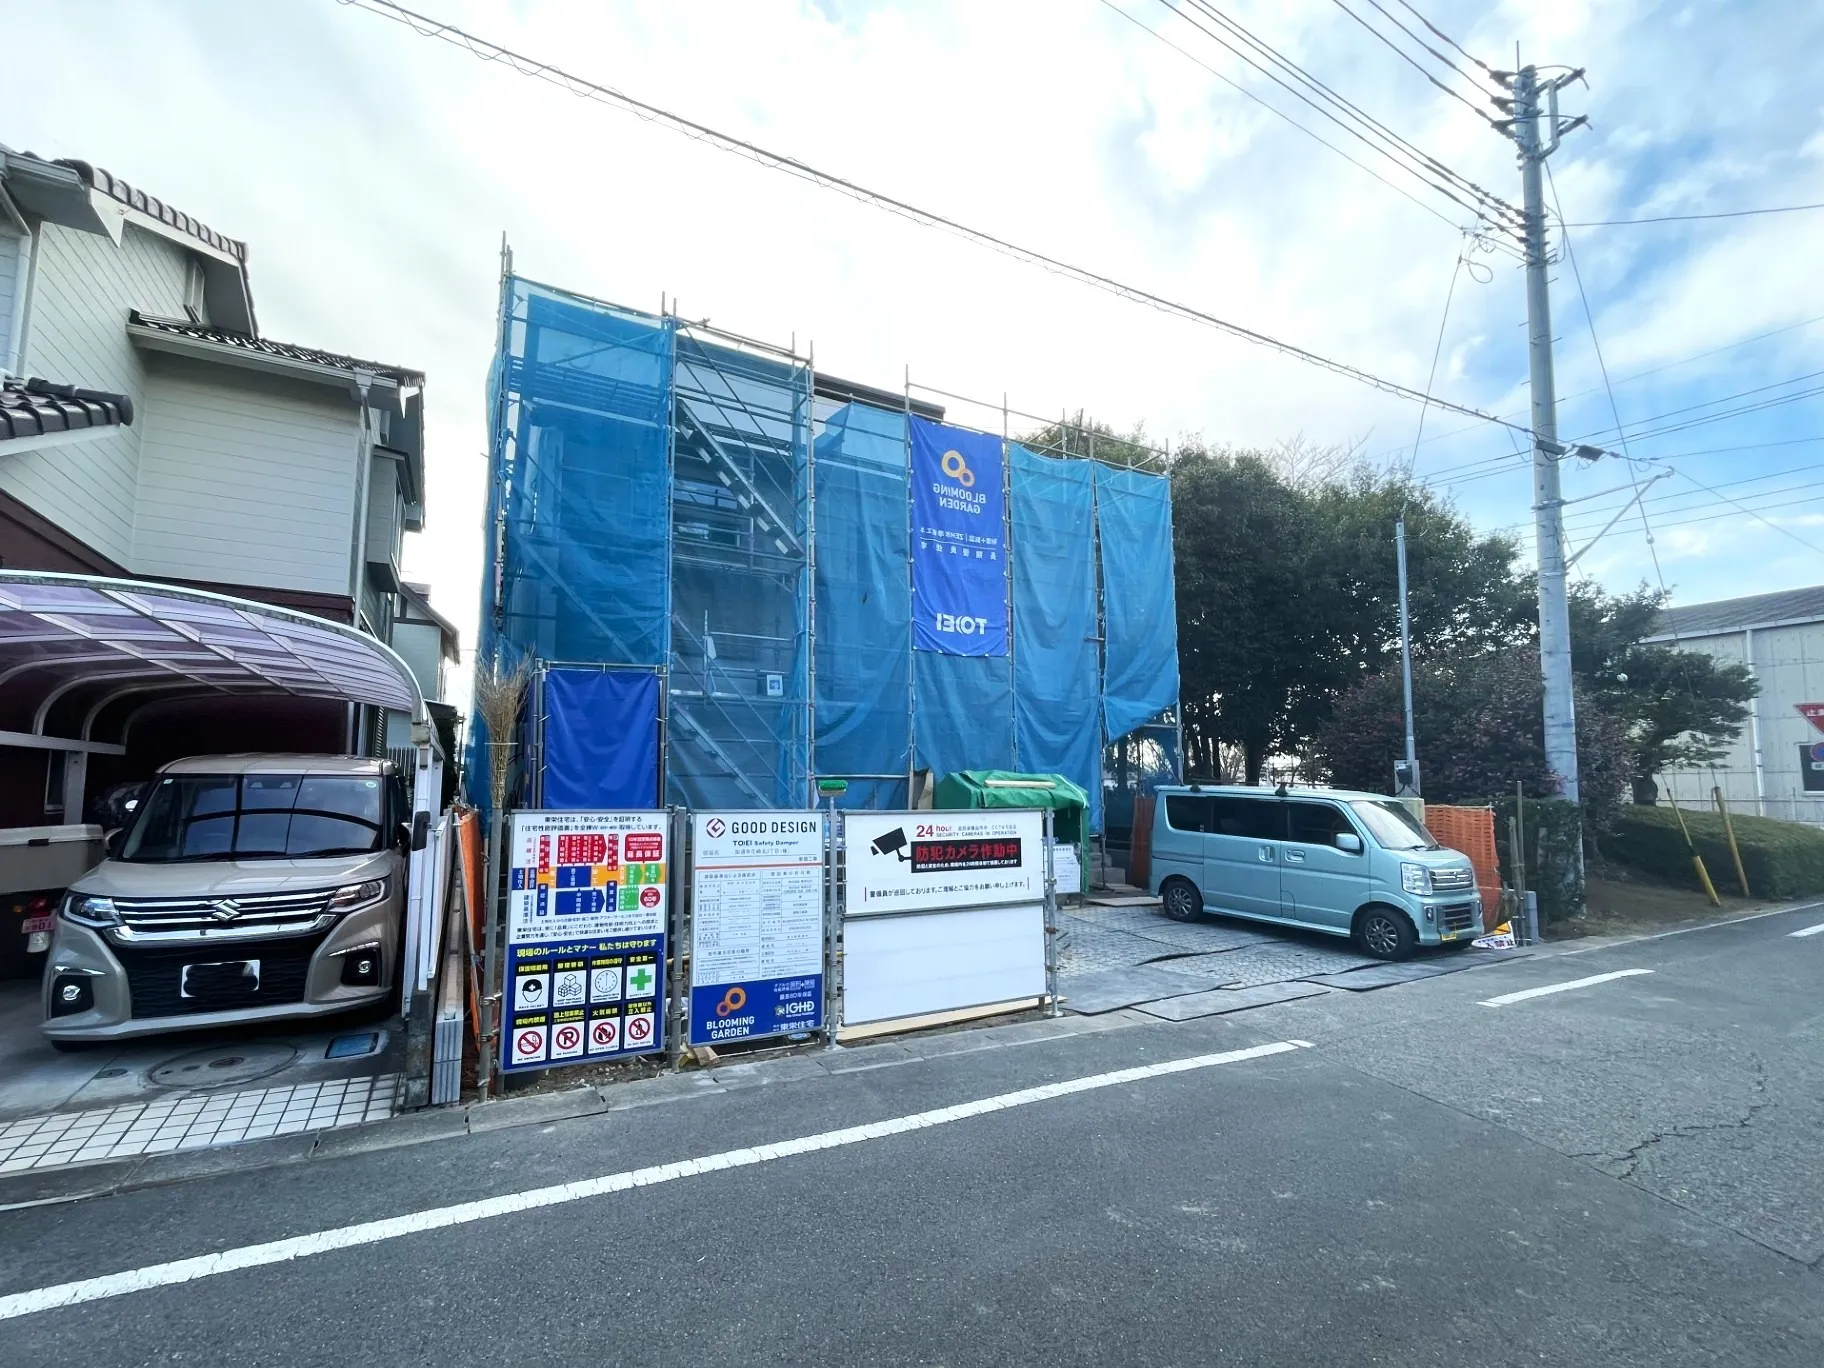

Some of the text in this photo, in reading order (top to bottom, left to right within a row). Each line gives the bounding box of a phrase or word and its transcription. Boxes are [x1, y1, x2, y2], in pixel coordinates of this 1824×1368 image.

[732, 822, 816, 834] GOOD DESIGN
[916, 825, 934, 838] 24
[916, 843, 1017, 862] 防犯カメラ作動中
[517, 939, 657, 957] 現場のルールとマナー 私たちは守ります
[786, 1001, 814, 1014] IGHD
[706, 1016, 754, 1030] BLOOMING
[711, 1027, 749, 1039] GARDEN
